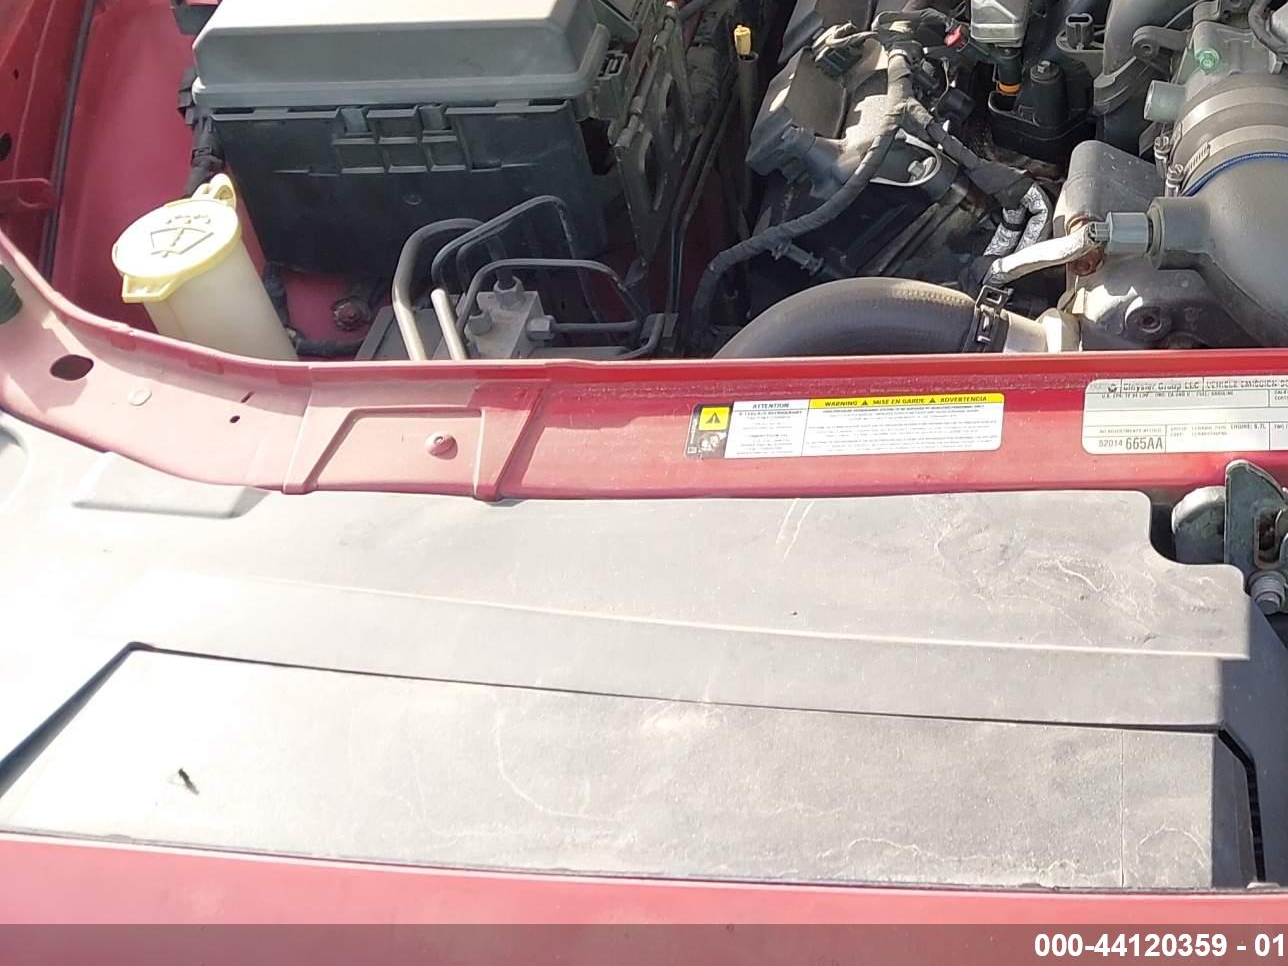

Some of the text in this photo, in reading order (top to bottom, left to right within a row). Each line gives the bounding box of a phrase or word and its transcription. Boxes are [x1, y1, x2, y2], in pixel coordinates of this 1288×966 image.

[1123, 381, 1199, 392] Chrysler Group LLC
[1206, 380, 1239, 388] VEHICLE
[1241, 379, 1277, 388] EMISSION
[1125, 437, 1163, 450] 665AA
